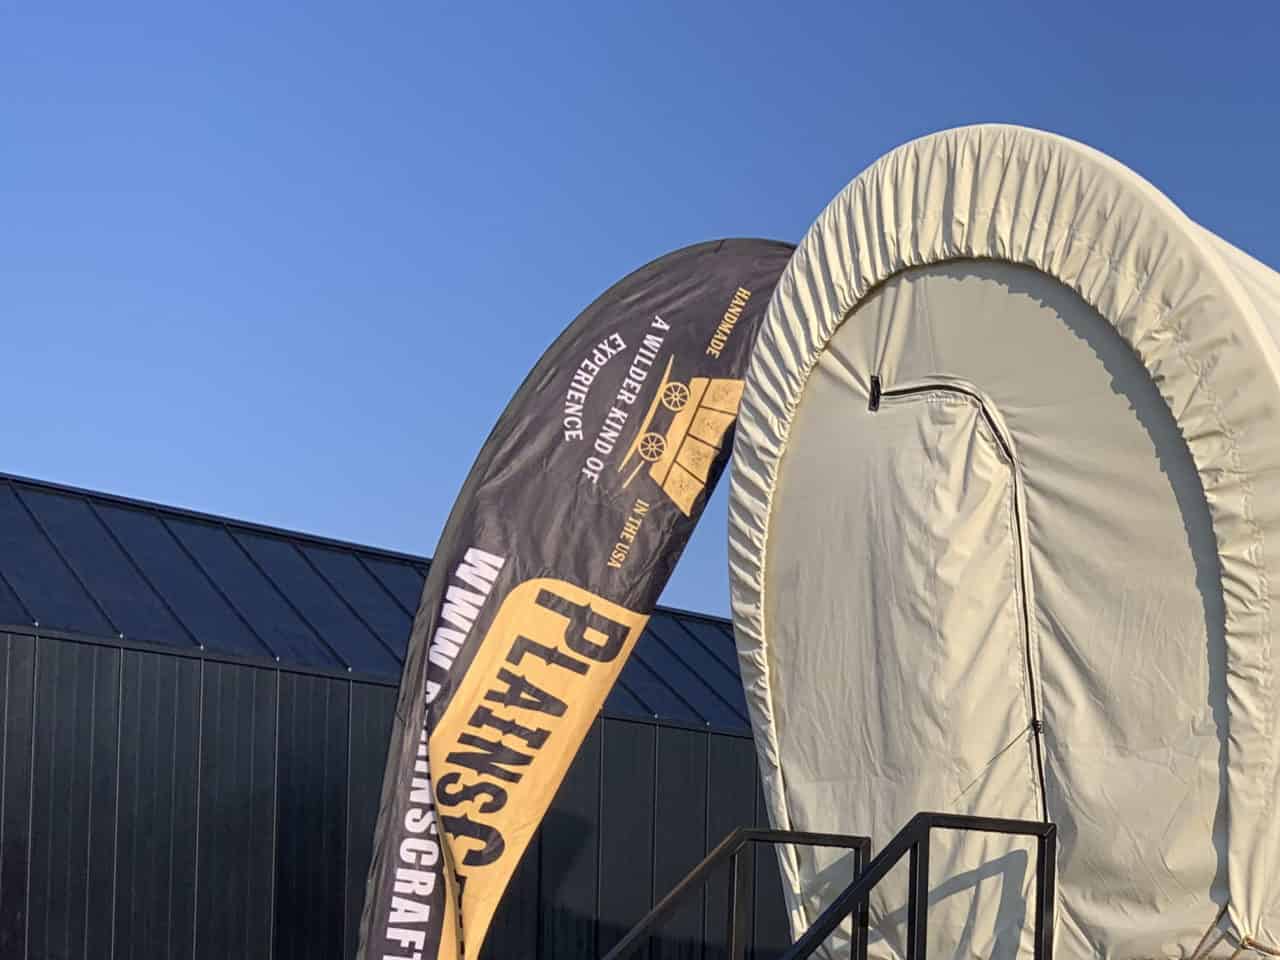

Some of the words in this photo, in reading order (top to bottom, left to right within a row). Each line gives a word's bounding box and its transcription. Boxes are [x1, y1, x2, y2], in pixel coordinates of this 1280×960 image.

[650, 315, 670, 332] A
[705, 287, 752, 359] HANDMADE
[616, 333, 665, 404] WILDER
[563, 332, 628, 442] EXPERIENCE
[594, 406, 629, 453] KIND
[582, 458, 605, 485] OF
[635, 498, 650, 515] IN
[620, 514, 643, 544] THE
[606, 539, 630, 569] USA
